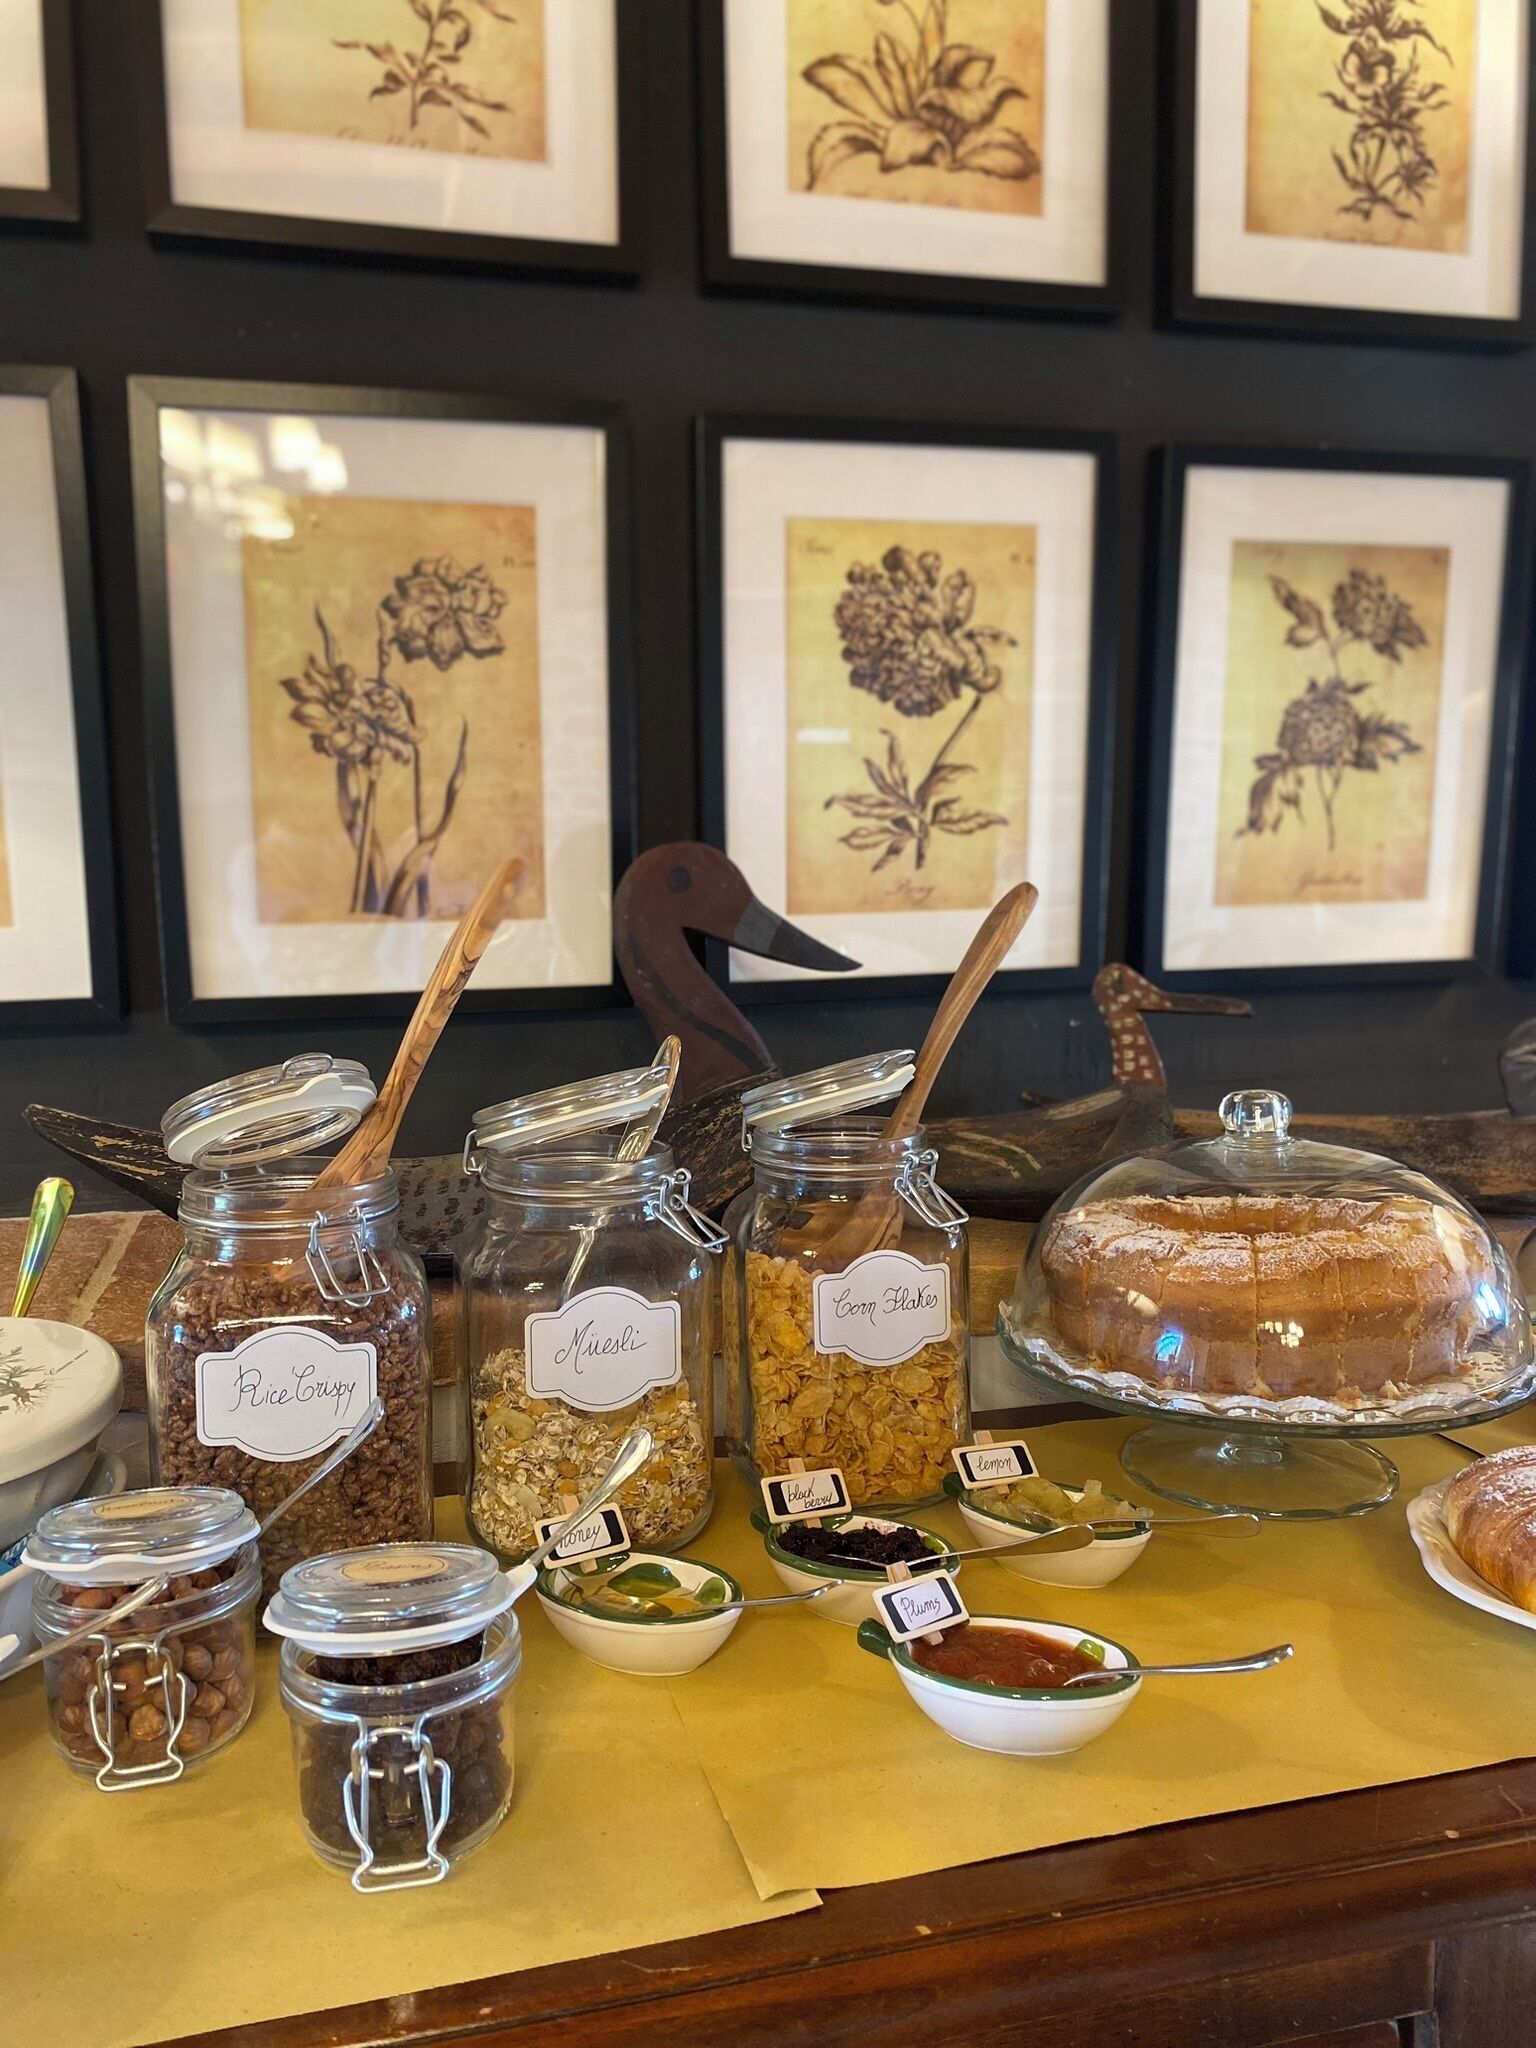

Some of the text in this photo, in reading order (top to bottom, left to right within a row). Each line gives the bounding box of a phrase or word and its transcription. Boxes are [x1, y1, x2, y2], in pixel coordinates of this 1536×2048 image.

[833, 1284, 938, 1327] Corn Flakes
[554, 1320, 648, 1375] Müesli
[228, 1364, 356, 1420] Rice Crispy
[976, 1455, 1014, 1475] lemon
[899, 1596, 942, 1623] Plums
